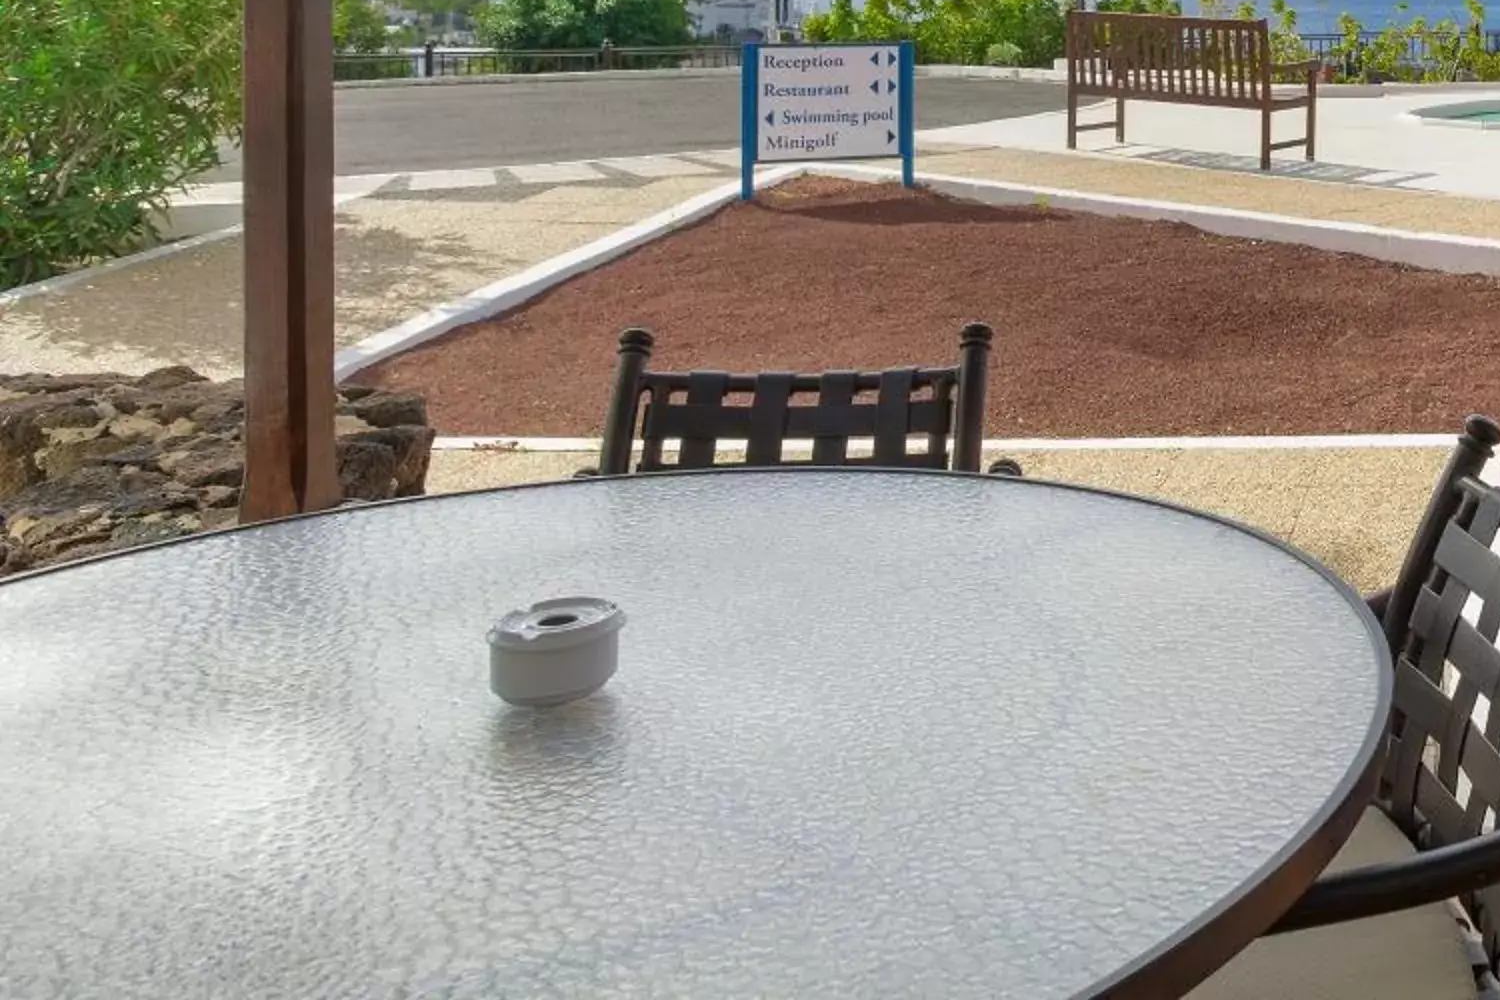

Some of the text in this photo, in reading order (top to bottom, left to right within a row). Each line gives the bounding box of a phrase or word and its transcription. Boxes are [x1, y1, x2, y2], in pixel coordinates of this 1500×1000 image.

[763, 55, 844, 72] Reception
[763, 83, 850, 97] Restaurant
[782, 106, 894, 126] Swimming pool
[766, 132, 839, 152] Minigolf
